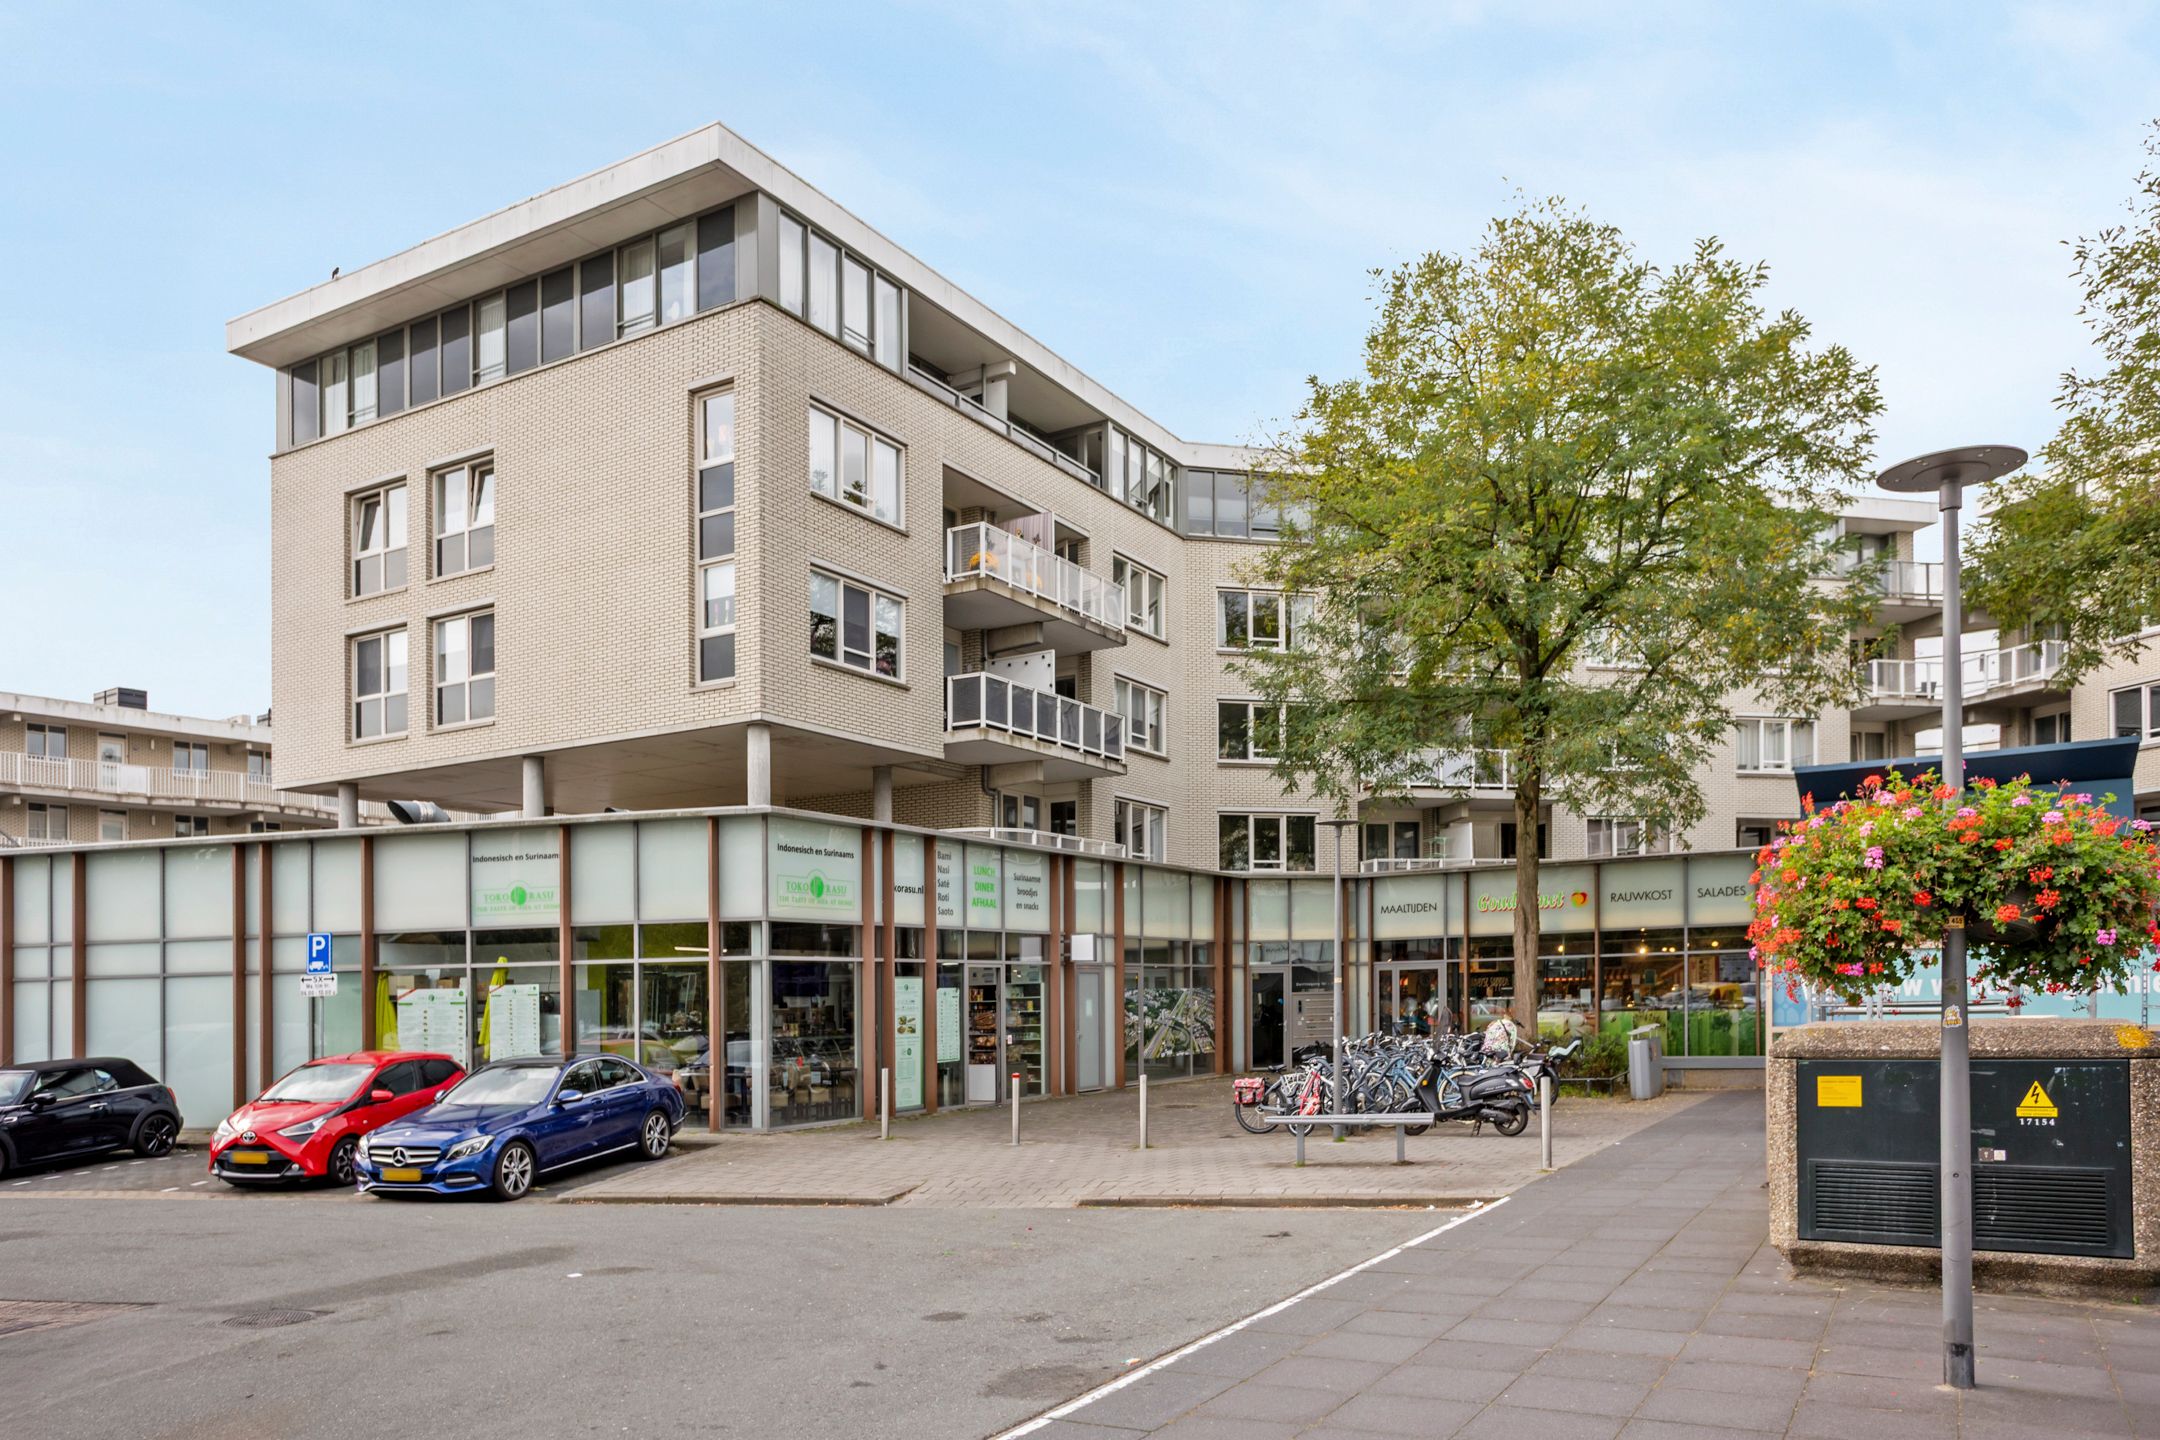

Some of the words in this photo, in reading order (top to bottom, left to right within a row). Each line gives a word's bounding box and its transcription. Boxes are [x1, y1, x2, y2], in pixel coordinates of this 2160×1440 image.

[777, 843, 814, 855] Indonesisch
[824, 848, 854, 859] Surinaams
[937, 851, 952, 860] Bami
[472, 854, 513, 863] Indonesisch
[525, 853, 560, 861] Surinaam
[937, 865, 950, 874] Nasi
[973, 865, 996, 877] LUNCH
[1013, 873, 1041, 883] Surinaamse
[786, 881, 809, 891] TOKO
[825, 884, 848, 894] RASU
[974, 882, 995, 893] DINER
[1016, 887, 1039, 898] broodjes
[1697, 885, 1747, 898] SALADES
[937, 893, 950, 902] Roti
[1610, 889, 1673, 902] RAUWKOST
[971, 897, 997, 909] AFHAAL
[1023, 902, 1039, 911] snacks
[1380, 902, 1438, 914] MAALTIJDEN
[937, 906, 954, 916] Saoto
[312, 936, 326, 958] P
[2019, 1118, 2056, 1126] 17154
